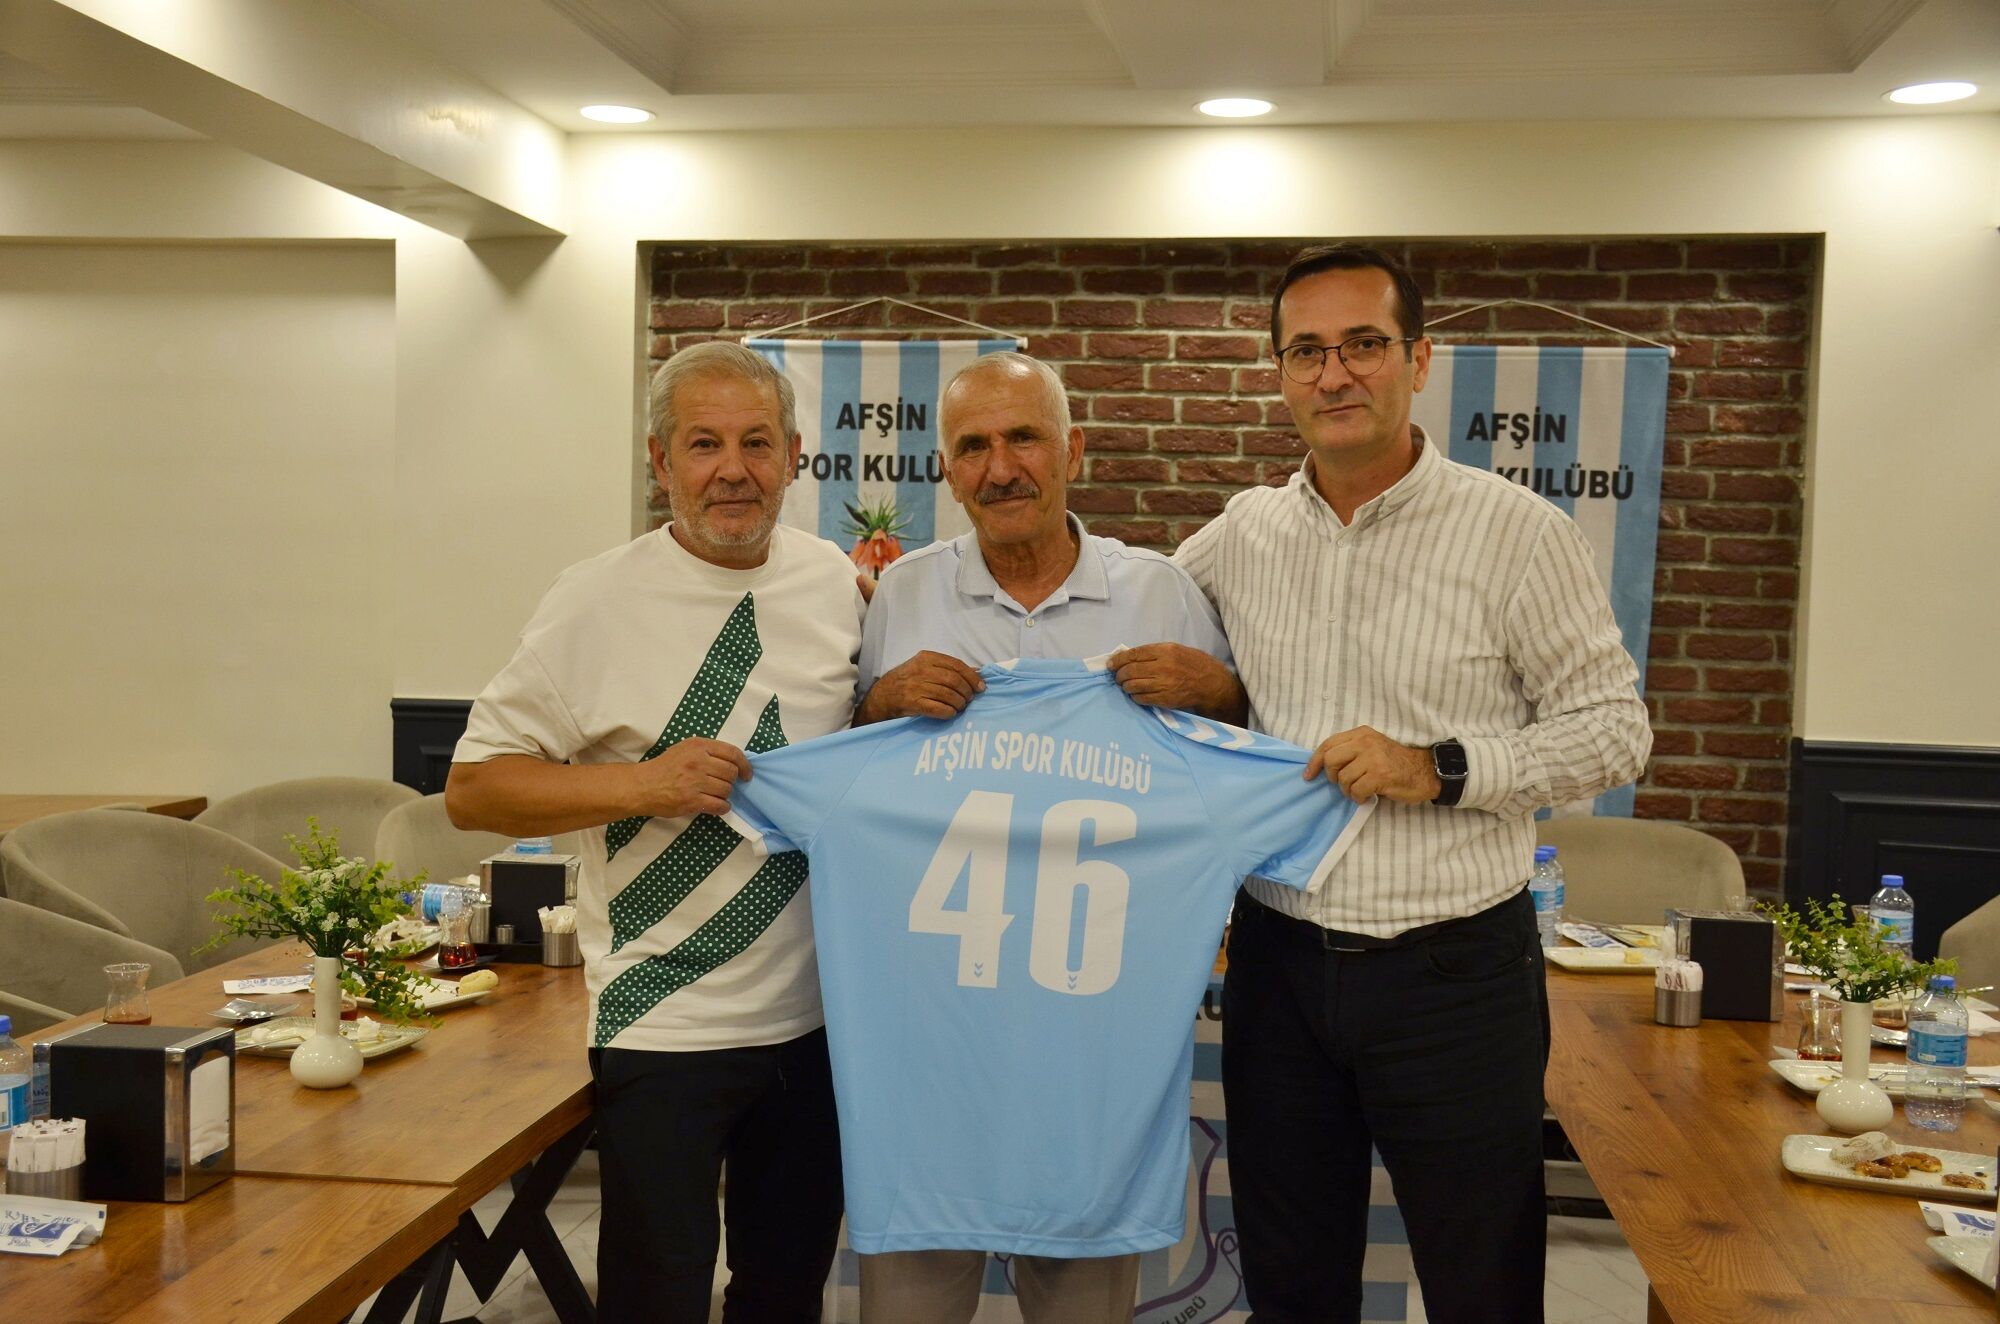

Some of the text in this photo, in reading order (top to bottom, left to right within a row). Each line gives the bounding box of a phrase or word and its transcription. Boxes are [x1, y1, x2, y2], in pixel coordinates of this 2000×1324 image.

[836, 397, 926, 437] AFŞİN
[1466, 406, 1566, 449] AFŞİN
[793, 450, 945, 483] POR KULÜ
[913, 721, 1151, 794] AFŞİN SPOR KULÜBÜ
[908, 790, 1137, 995] 46
